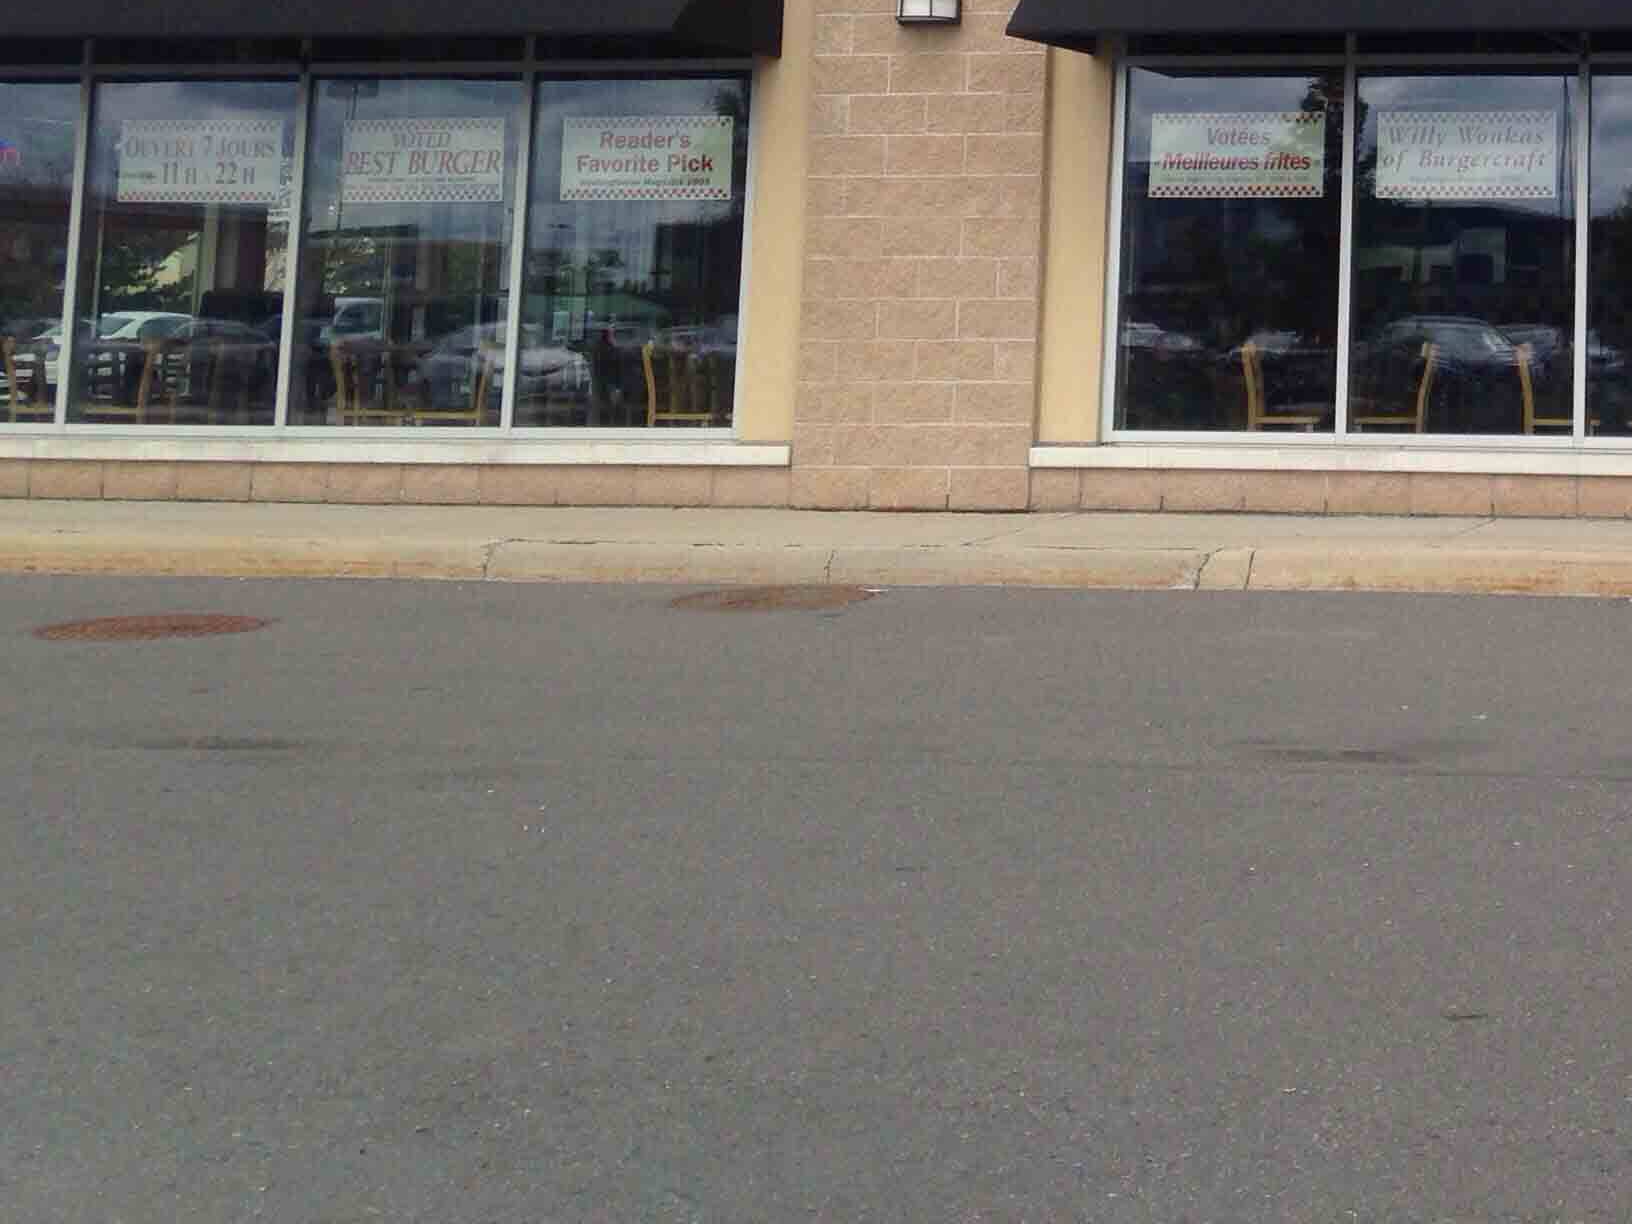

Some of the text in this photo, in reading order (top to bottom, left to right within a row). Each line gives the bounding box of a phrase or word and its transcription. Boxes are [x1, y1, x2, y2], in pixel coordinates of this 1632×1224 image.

[599, 129, 692, 151] Reader's
[344, 149, 502, 176] BEST BURGER
[576, 152, 714, 174] Favorite Pick
[1161, 152, 1259, 171] Meilleures
[214, 161, 238, 185] 22
